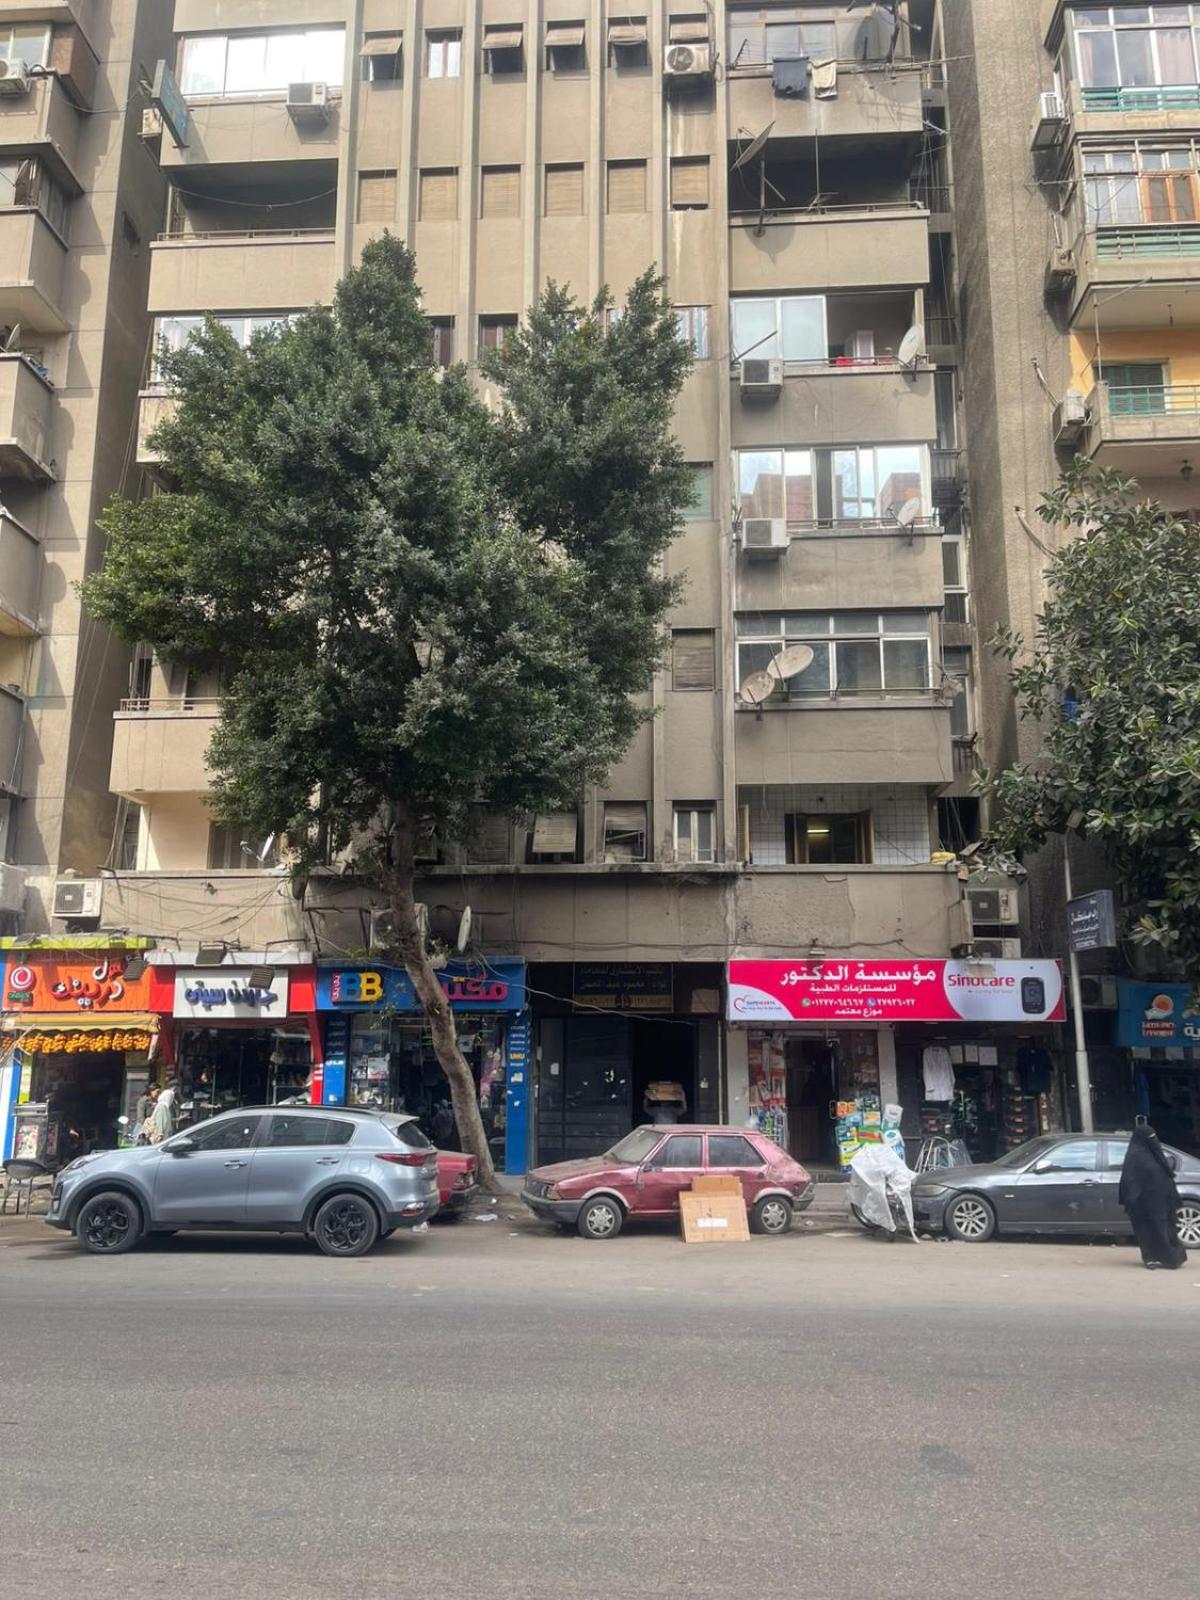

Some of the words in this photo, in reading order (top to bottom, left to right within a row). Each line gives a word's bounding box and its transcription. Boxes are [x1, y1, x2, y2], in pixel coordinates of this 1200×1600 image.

[779, 964, 849, 985] الدكتور
[854, 963, 937, 985] مؤسسة
[947, 974, 1016, 987] Sinocare
[52, 976, 124, 1007] درينك
[340, 972, 384, 1002] BB
[809, 984, 840, 994] الطبية
[842, 984, 897, 994] للمستلزمات
[835, 1007, 862, 1016] معتمد
[863, 1008, 883, 1018] موزع
